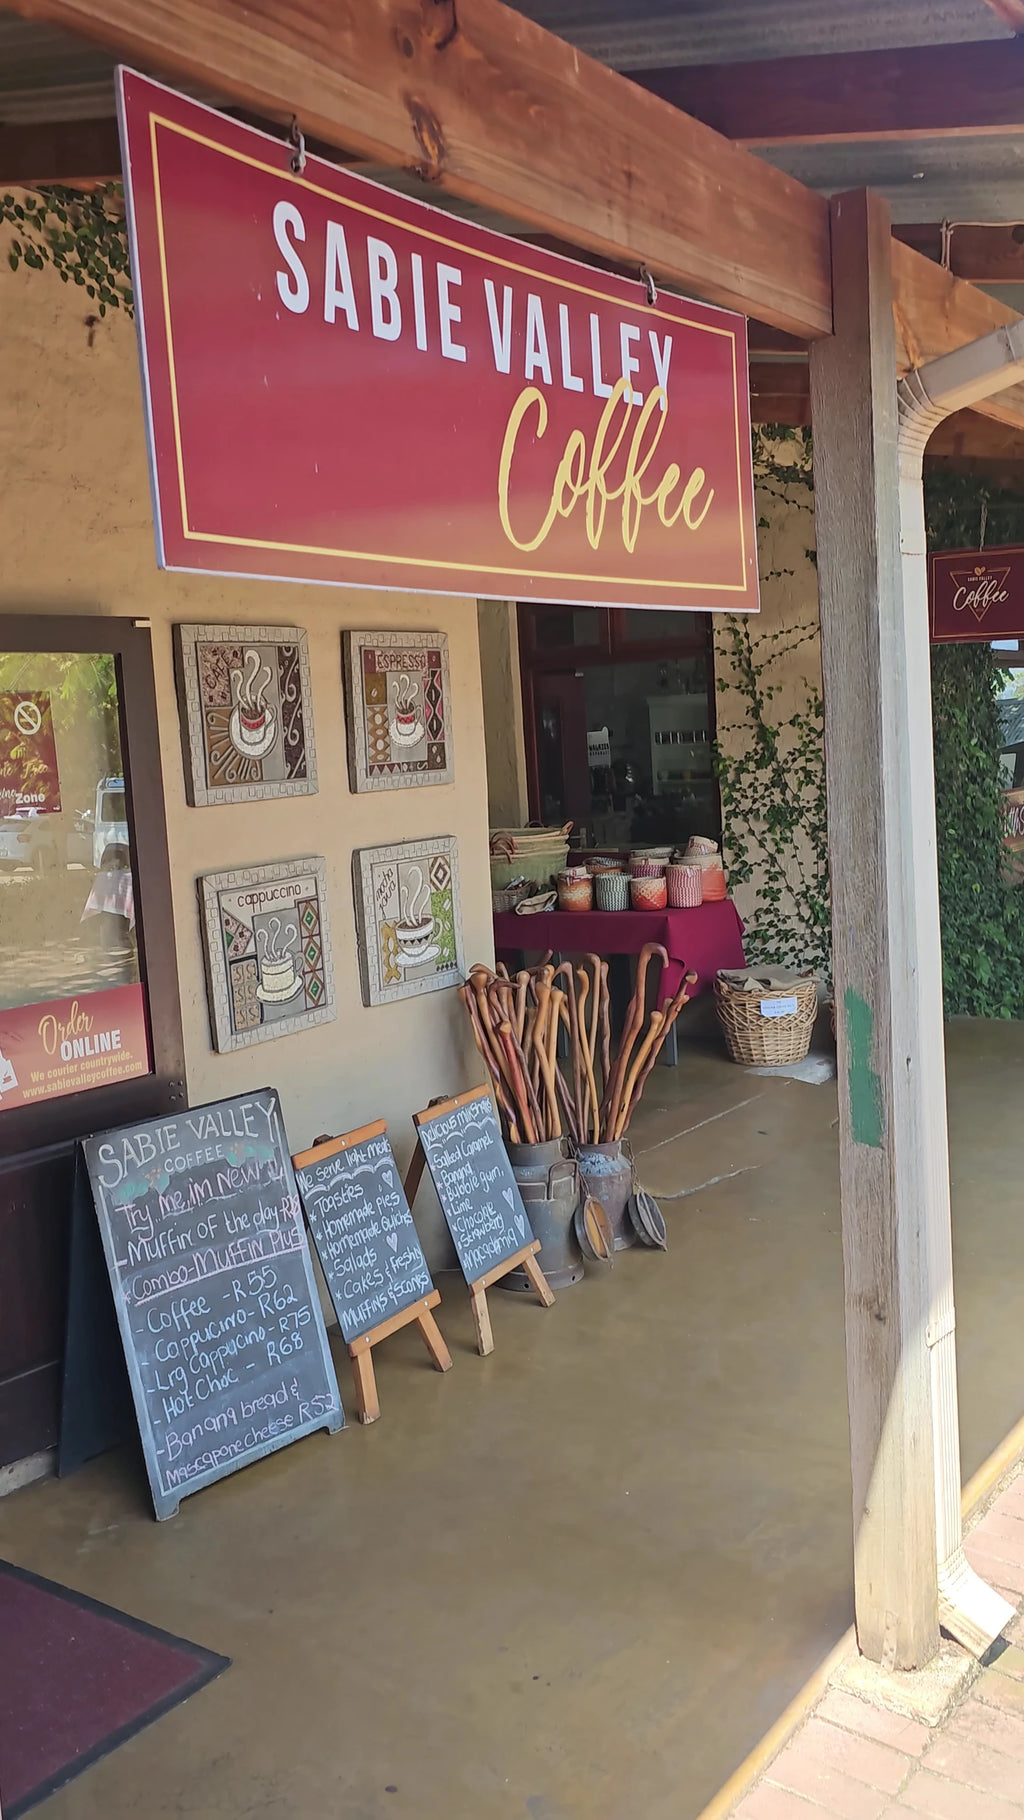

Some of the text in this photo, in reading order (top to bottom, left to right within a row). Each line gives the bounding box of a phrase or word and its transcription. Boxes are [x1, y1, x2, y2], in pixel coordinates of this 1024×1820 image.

[273, 200, 672, 411] SABIE VALLEY
[499, 378, 714, 553] Coffee
[953, 580, 1010, 611] Coffee
[377, 653, 427, 669] ESPRESSO
[237, 884, 302, 913] cappuccino
[38, 1000, 94, 1055] Order
[60, 1029, 122, 1062] ONLINE
[22, 1061, 143, 1099] www.sabievalleycoffee.com
[30, 1051, 133, 1083] We courier countrywide.
[98, 1097, 276, 1189] SABIE VALLEY
[164, 1144, 224, 1173] COFFEE
[295, 1171, 314, 1194] We
[223, 1210, 251, 1234] the
[450, 1198, 473, 1216] Lime
[333, 1246, 377, 1277] Salads
[147, 1295, 211, 1334] Coffee
[258, 1284, 299, 1318] R62
[163, 1391, 195, 1423] Hot
[266, 1331, 304, 1367] R68
[166, 1407, 238, 1462] Banana
[241, 1381, 289, 1419] bread
